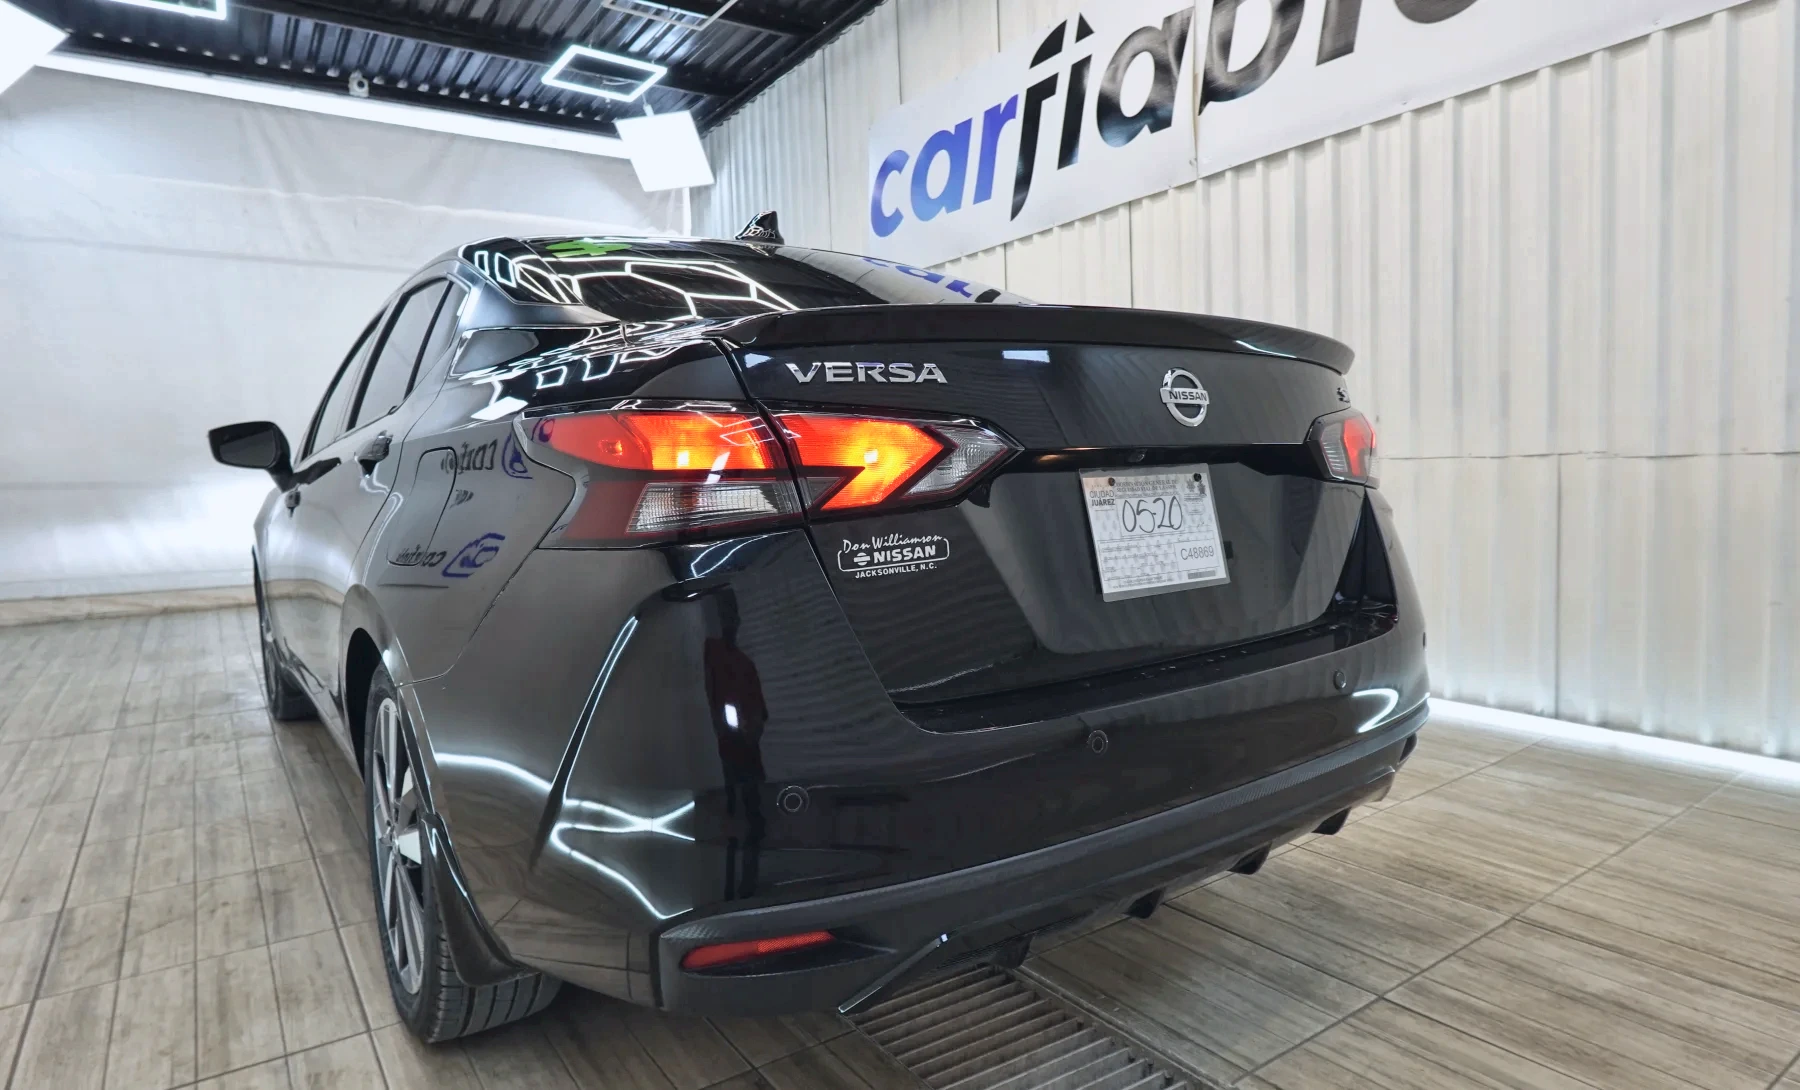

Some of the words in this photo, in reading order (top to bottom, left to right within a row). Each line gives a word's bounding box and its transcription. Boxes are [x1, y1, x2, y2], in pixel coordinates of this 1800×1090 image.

[785, 362, 948, 383] VERSA
[1169, 391, 1207, 401] NISSAN
[1089, 490, 1114, 498] CIUDAD
[1122, 495, 1183, 533] 0520
[842, 539, 871, 553] Don
[871, 533, 942, 549] Williamson
[873, 545, 936, 563] NISSAN
[1180, 546, 1214, 560] C48869
[855, 565, 918, 579] JACKSONVILLE,
[920, 562, 937, 570] N.C.
